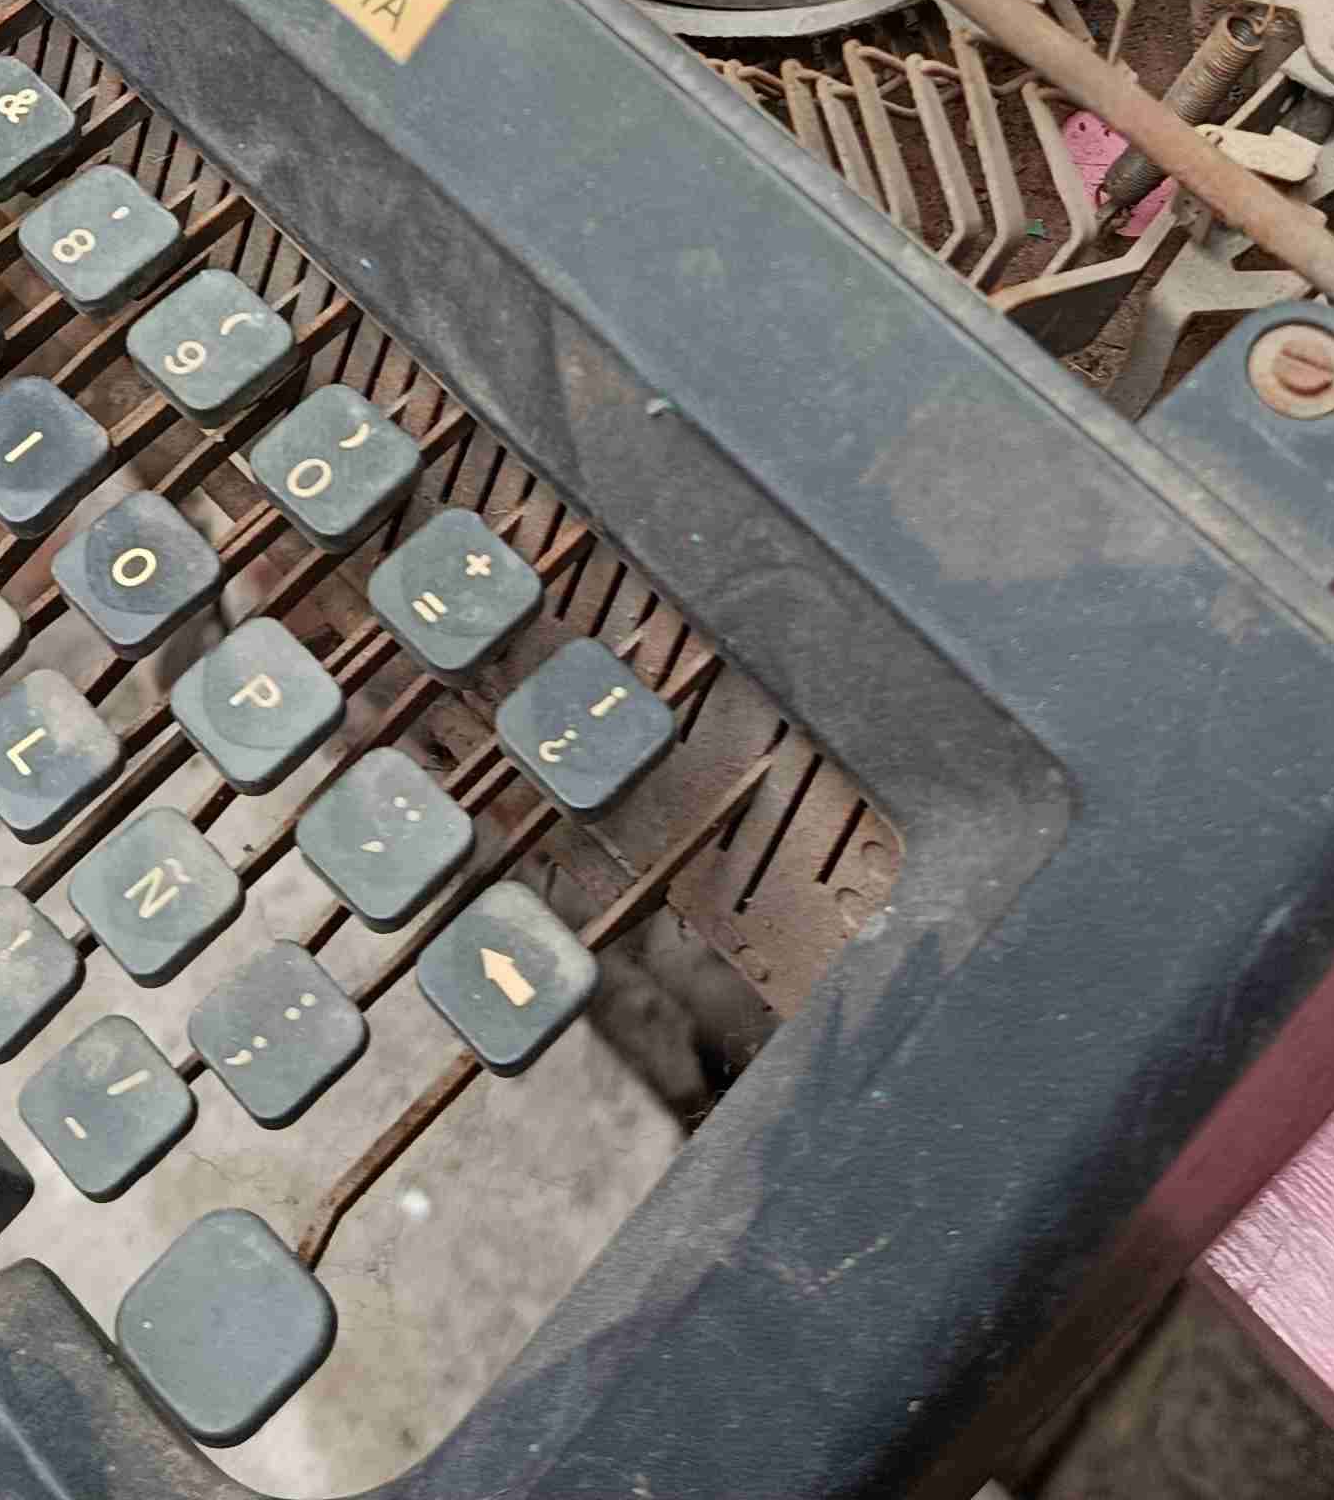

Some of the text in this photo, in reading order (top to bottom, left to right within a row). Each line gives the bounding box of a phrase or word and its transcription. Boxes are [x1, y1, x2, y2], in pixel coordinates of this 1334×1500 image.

[52, 228, 96, 263] 8
[164, 341, 207, 375] 9
[4, 431, 44, 462] I
[111, 547, 157, 587] O
[412, 591, 447, 622] =
[229, 673, 281, 708] P
[6, 727, 47, 776] L
[122, 858, 192, 919] Ñ
